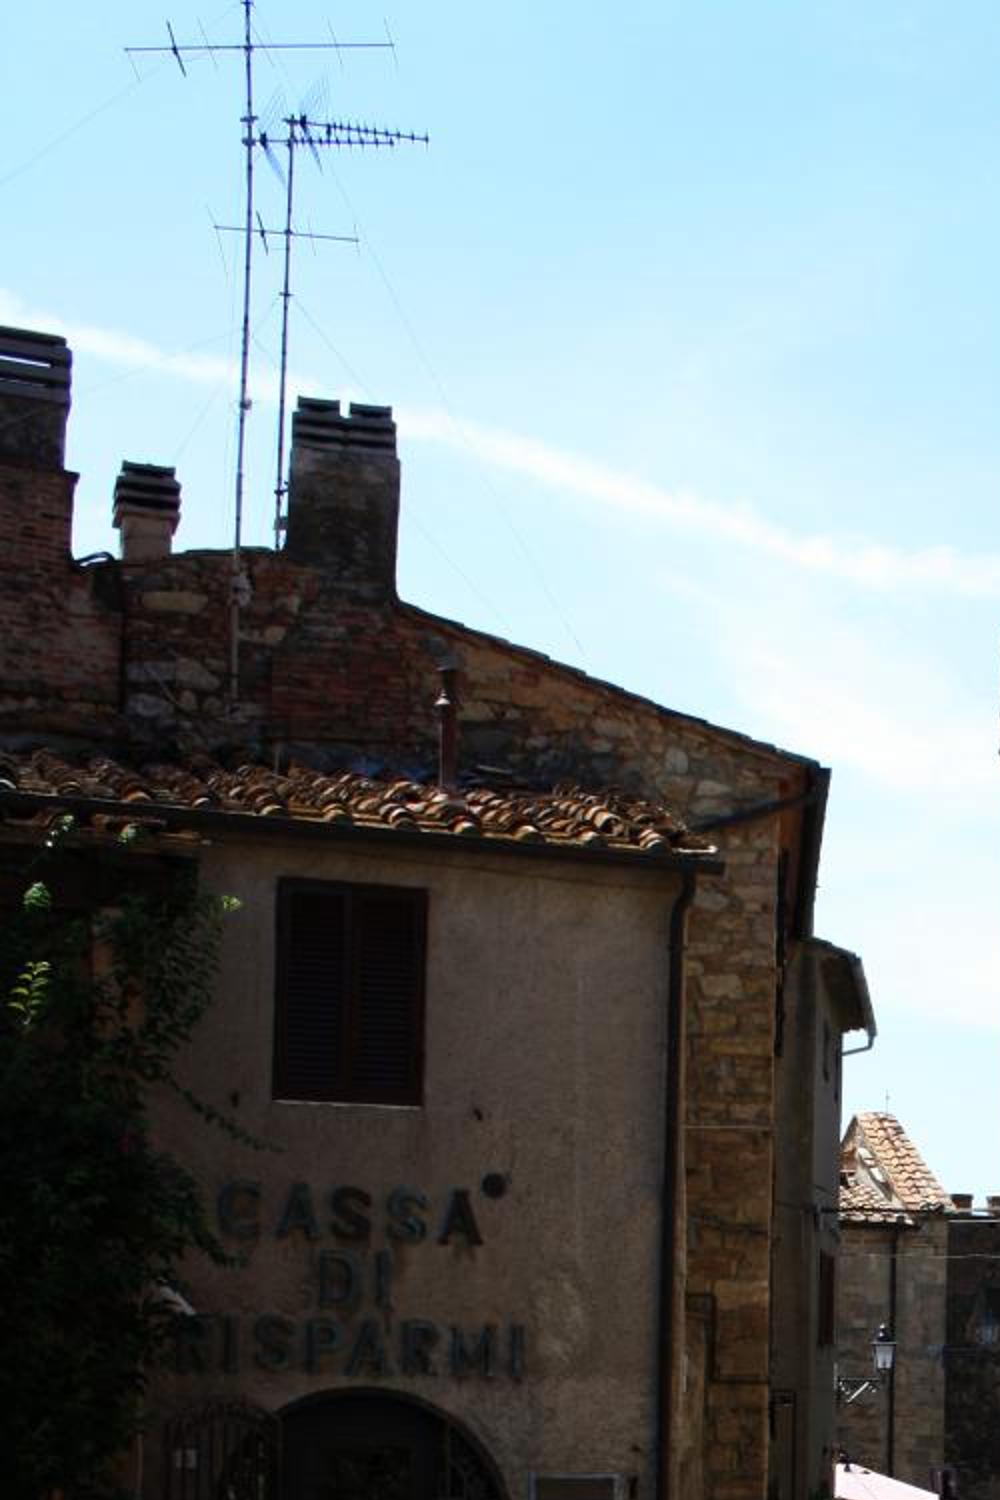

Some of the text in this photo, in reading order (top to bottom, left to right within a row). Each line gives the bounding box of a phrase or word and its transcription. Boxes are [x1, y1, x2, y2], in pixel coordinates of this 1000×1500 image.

[218, 1182, 483, 1246] CASSA
[317, 1248, 394, 1312] DI
[174, 1314, 528, 1381] RISPARMI
